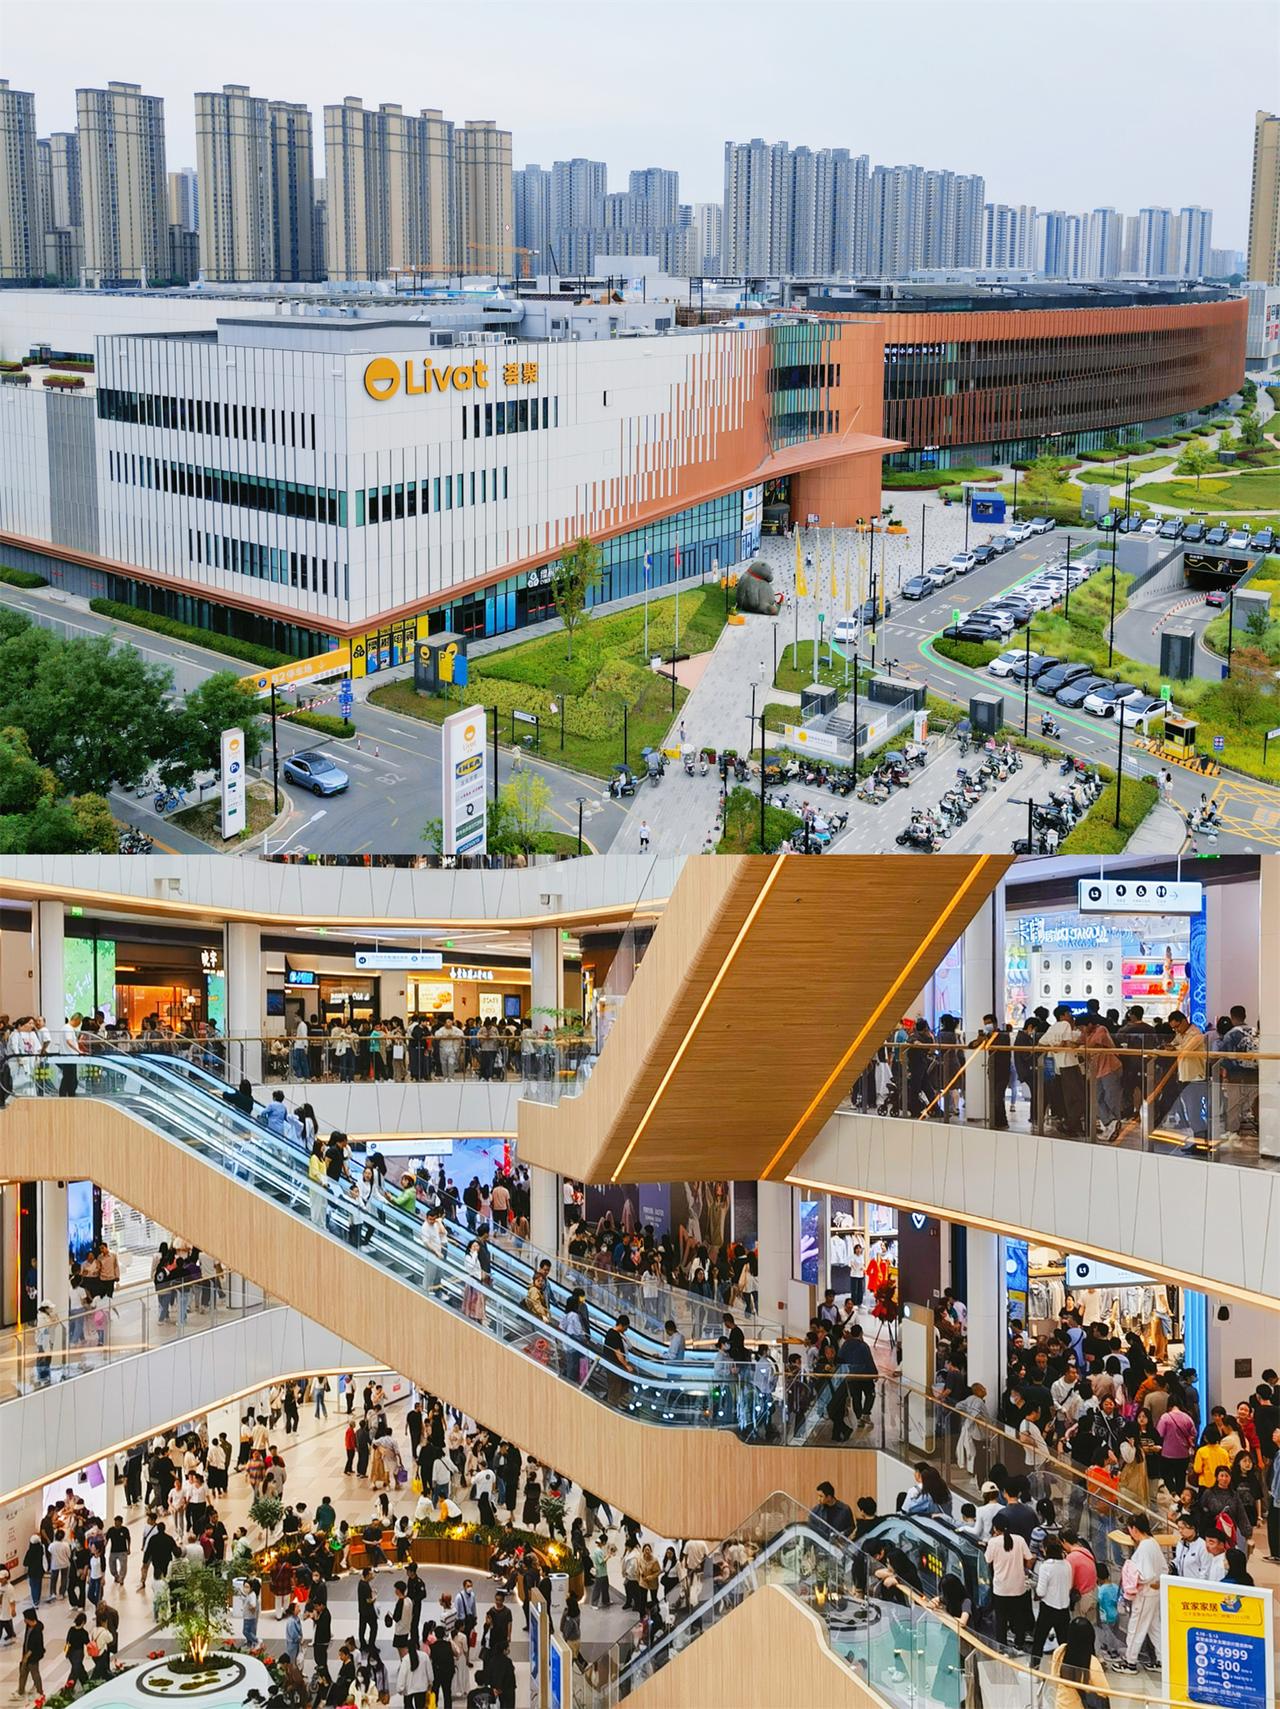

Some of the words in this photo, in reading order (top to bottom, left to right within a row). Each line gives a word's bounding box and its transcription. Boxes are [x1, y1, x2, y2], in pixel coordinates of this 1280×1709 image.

[405, 357, 489, 395] Livat
[503, 362, 539, 386] 荟聚
[458, 758, 481, 774] IKEA
[1079, 1265, 1087, 1274] L1
[1181, 1601, 1218, 1612] 宜家家居
